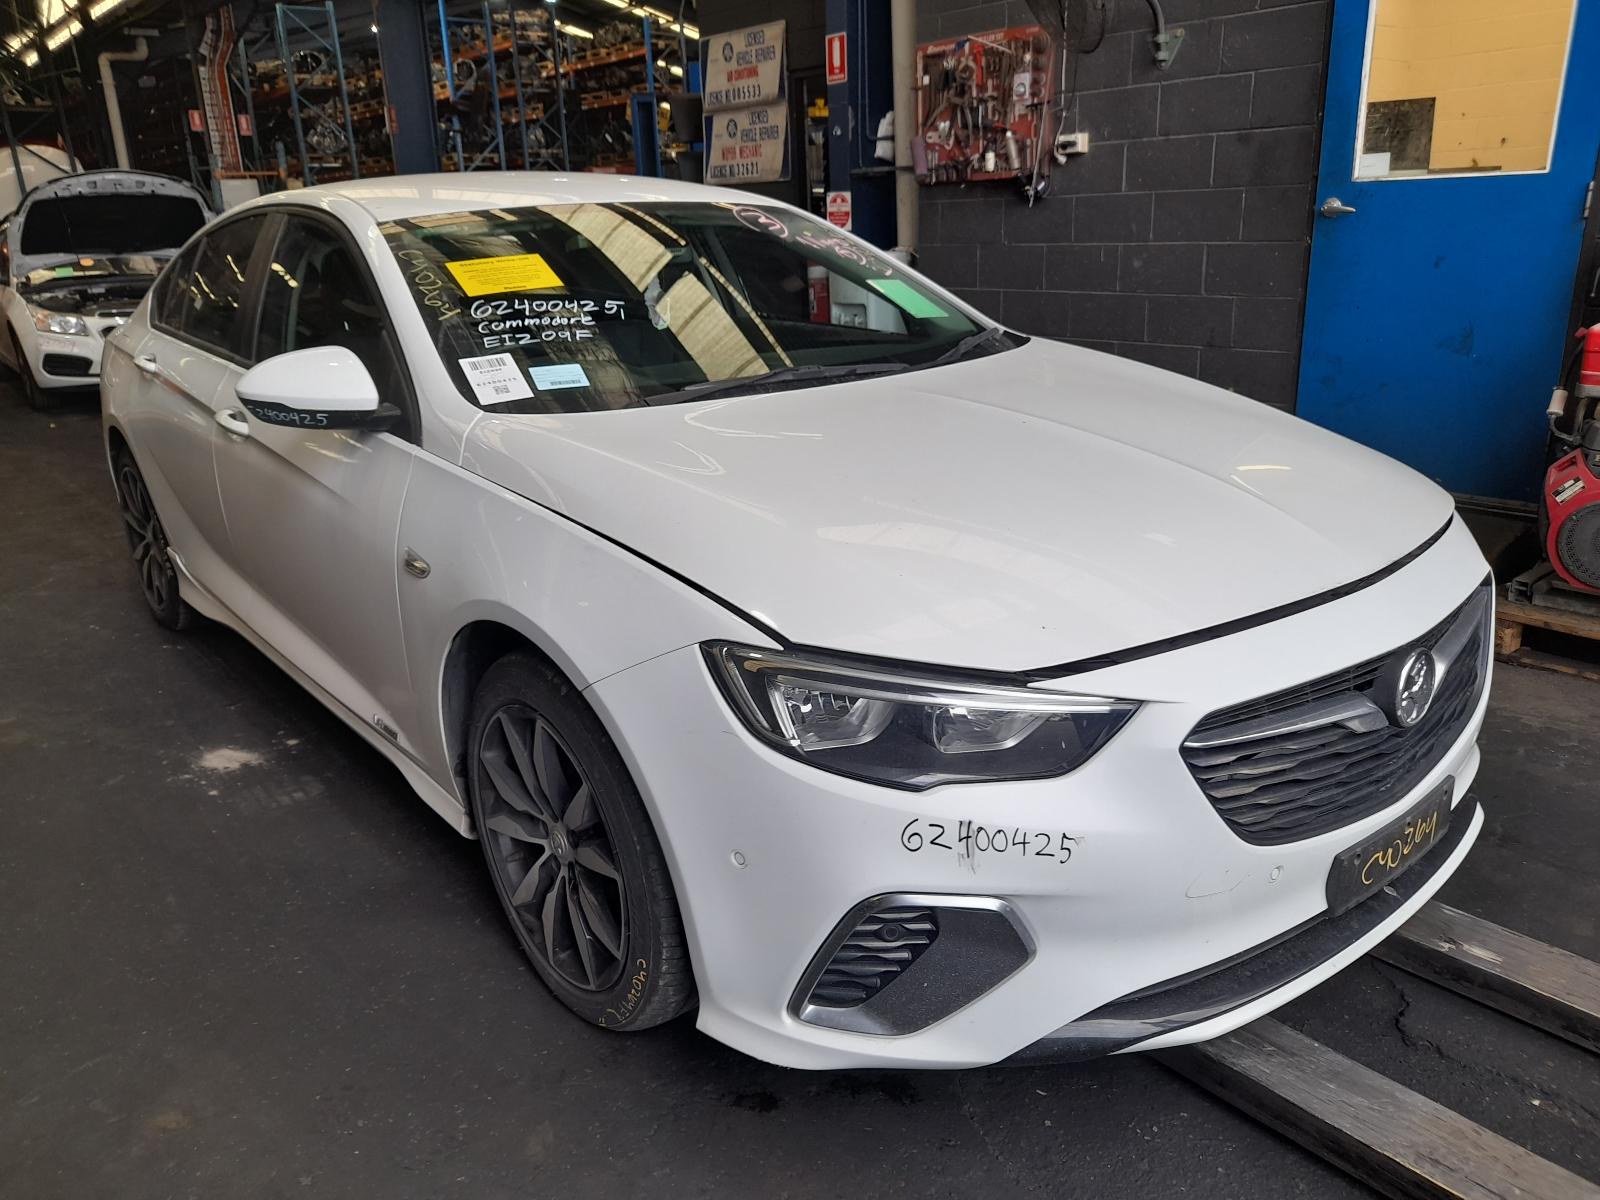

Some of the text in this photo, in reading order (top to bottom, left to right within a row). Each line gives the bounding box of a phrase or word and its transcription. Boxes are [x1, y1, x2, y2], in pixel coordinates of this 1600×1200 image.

[736, 45, 776, 66] VEHICLE REPAIRER
[741, 125, 779, 143] VEHICLE REPAIRER
[900, 818, 1073, 864] 62400425
